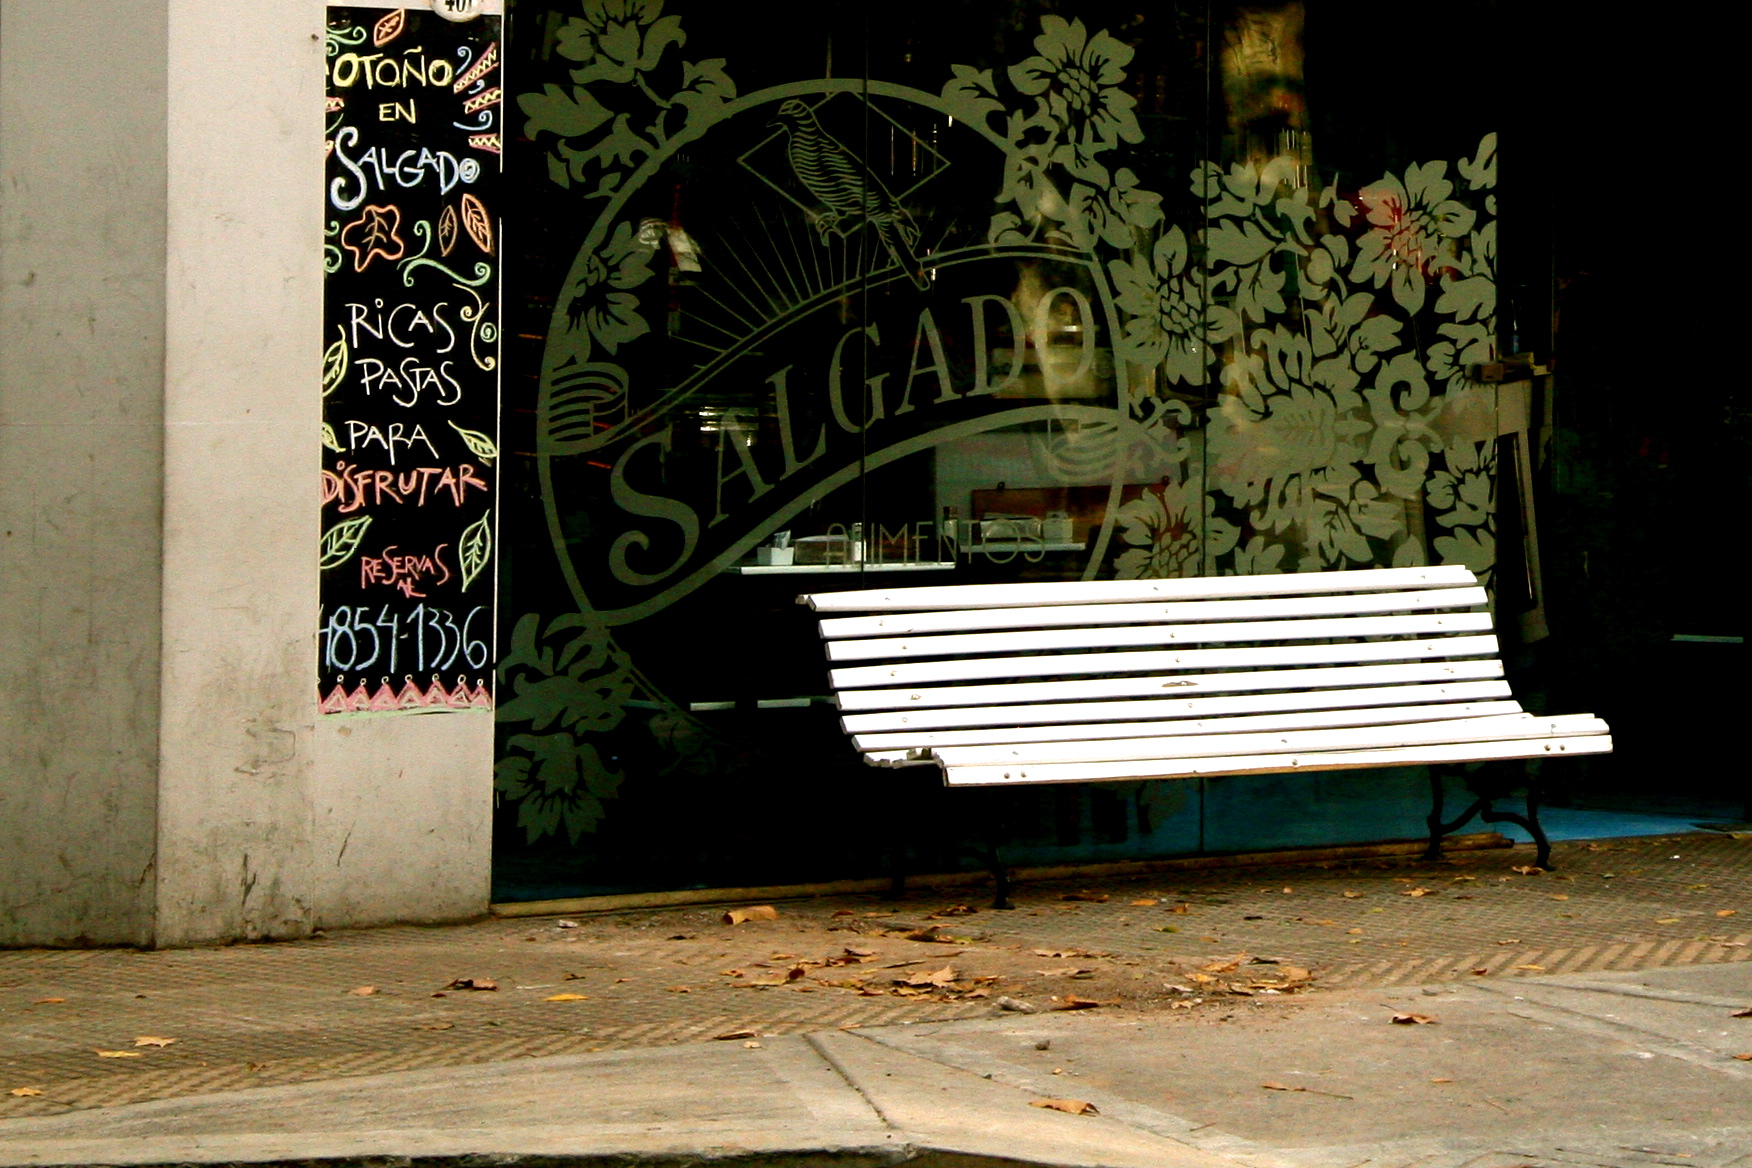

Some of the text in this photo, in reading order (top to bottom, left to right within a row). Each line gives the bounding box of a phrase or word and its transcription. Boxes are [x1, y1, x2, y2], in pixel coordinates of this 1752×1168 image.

[333, 46, 453, 90] OTOÑO
[379, 98, 416, 124] EN
[331, 126, 480, 210] SALGADO
[354, 357, 461, 407] PASTAS
[345, 420, 439, 465] PARA
[608, 287, 1096, 586] SALGADO
[361, 543, 449, 589] RESERVAS
